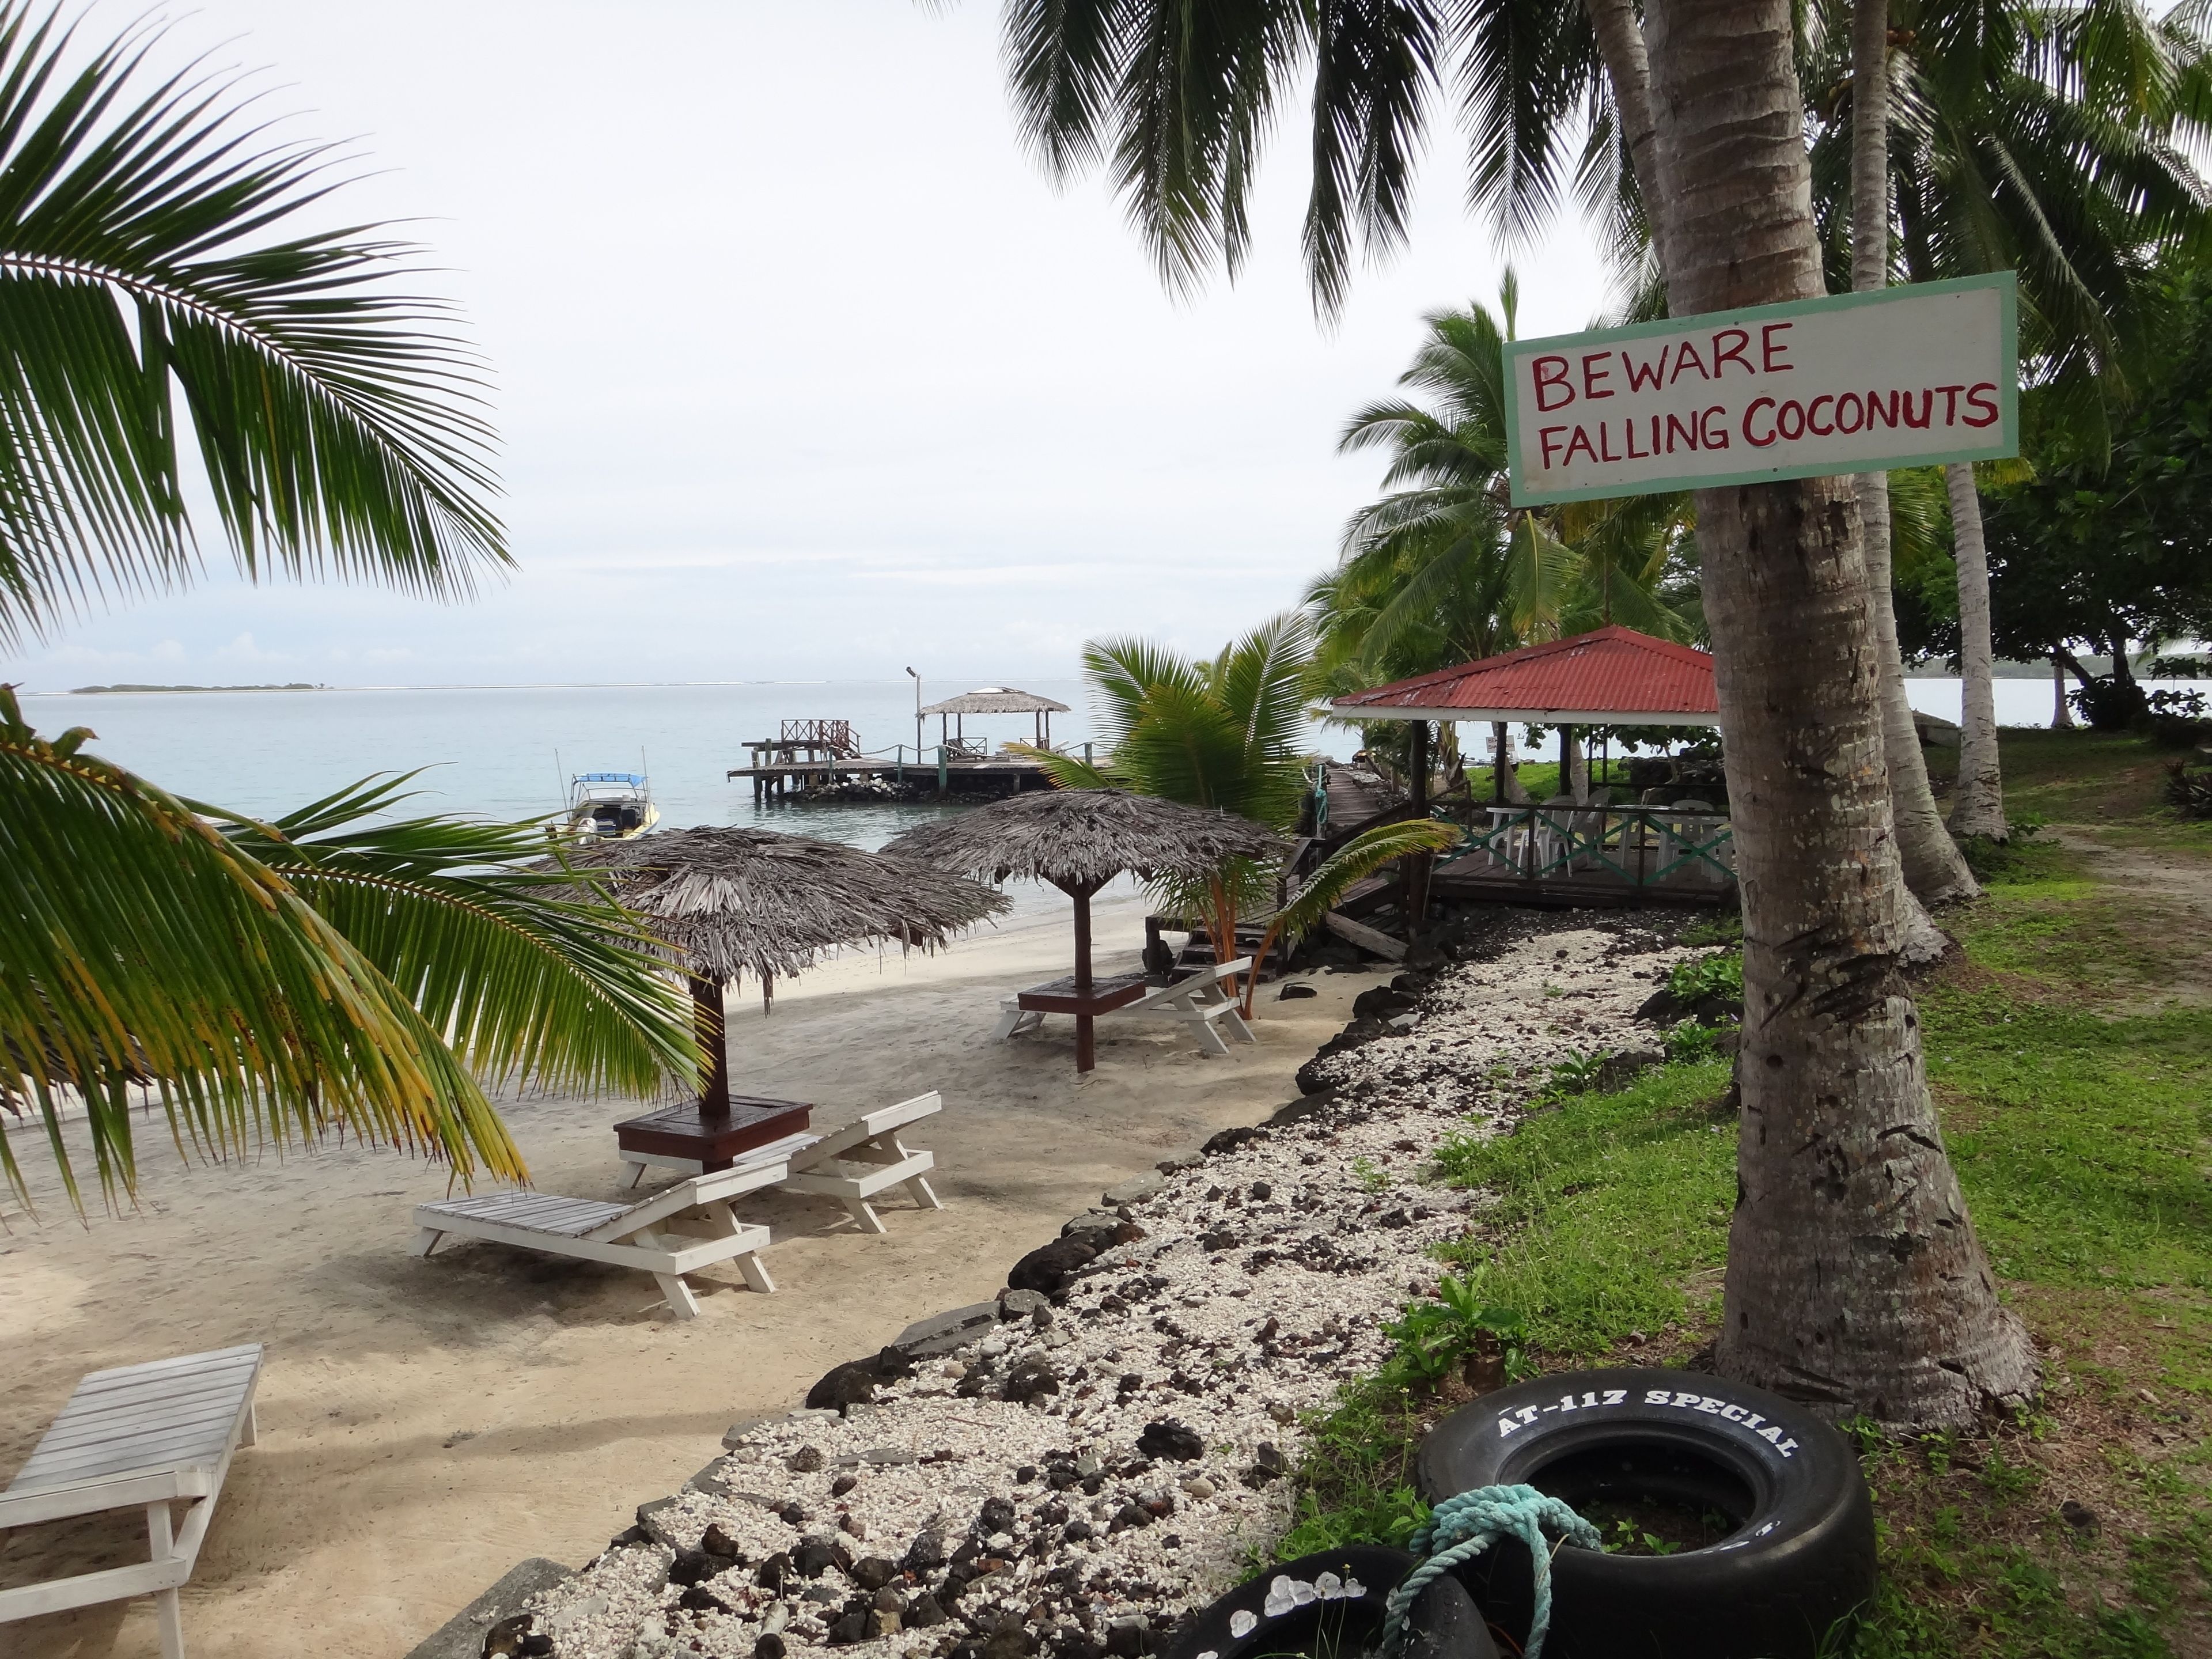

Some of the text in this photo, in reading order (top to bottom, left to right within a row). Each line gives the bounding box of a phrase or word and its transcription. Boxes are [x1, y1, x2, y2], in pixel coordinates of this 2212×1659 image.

[1532, 323, 1794, 412] BEWARE
[1538, 382, 1999, 470] FALLING COCONUTS
[1644, 1390, 1798, 1457] SPECIAL
